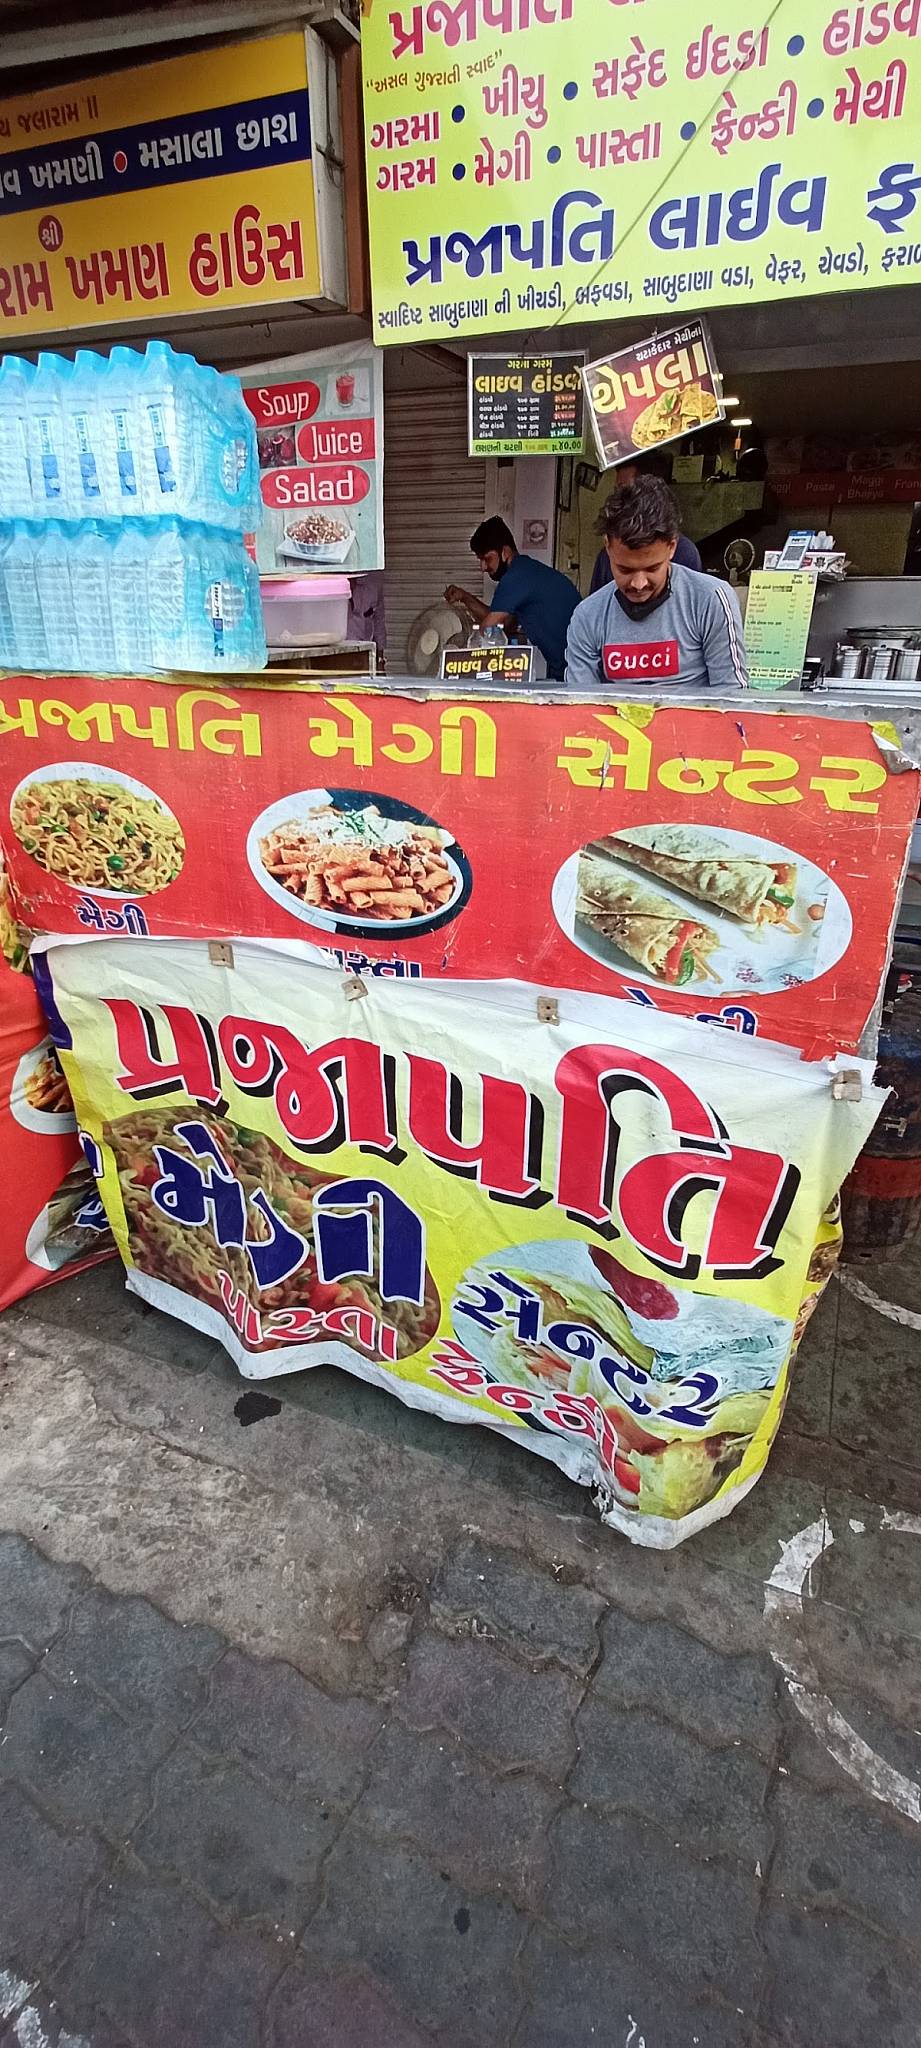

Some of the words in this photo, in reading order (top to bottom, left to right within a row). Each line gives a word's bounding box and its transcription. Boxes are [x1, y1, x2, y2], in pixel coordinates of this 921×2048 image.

[370, 111, 440, 149] ગરમા
[482, 63, 549, 129] ખીચુ
[592, 36, 667, 100] સફેદ
[414, 63, 461, 92] ગુજરાતી
[18, 102, 79, 133] જલારામ
[376, 157, 436, 192] ગરમ
[474, 129, 531, 186] મેગી
[575, 120, 661, 169] પાસ્તા
[711, 79, 798, 155] ફ્રેન્કી
[833, 58, 908, 125] મેથી
[28, 141, 104, 189] ખમણી
[138, 127, 223, 169] મસાલા
[236, 112, 297, 150] છાશ
[42, 220, 59, 246] શ્રી
[402, 190, 615, 286] પ્રજાપતિ
[649, 163, 827, 250] લાઈવ
[65, 242, 170, 305] ખમણ
[189, 204, 304, 297] હાઉસ
[378, 302, 423, 329] સ્વાદિષ્ટ
[429, 298, 488, 329] સાબુદાણા
[494, 288, 511, 314] ની
[643, 270, 713, 303] સાબુદાણા
[533, 359, 553, 369] ગરમ
[636, 340, 672, 362] ચટાકેદાર
[674, 326, 702, 345] મેથીના
[475, 375, 523, 393] લાઇવ
[592, 341, 708, 413] થેપલા
[258, 389, 309, 419] Soup
[312, 426, 362, 461] Juice
[275, 470, 354, 504] Salad
[446, 660, 482, 673] લાઇવ
[487, 653, 529, 671] હાંડવો
[607, 647, 671, 671] Gucci
[308, 697, 497, 778] મેગી
[556, 713, 887, 814] સેન્ટર
[77, 895, 149, 936] મેગી
[100, 998, 801, 1280] પ્રજાપતિ
[151, 1120, 426, 1306] મેગી
[216, 1270, 398, 1361] પાસ્તા
[453, 1270, 719, 1428] સેન્ટર
